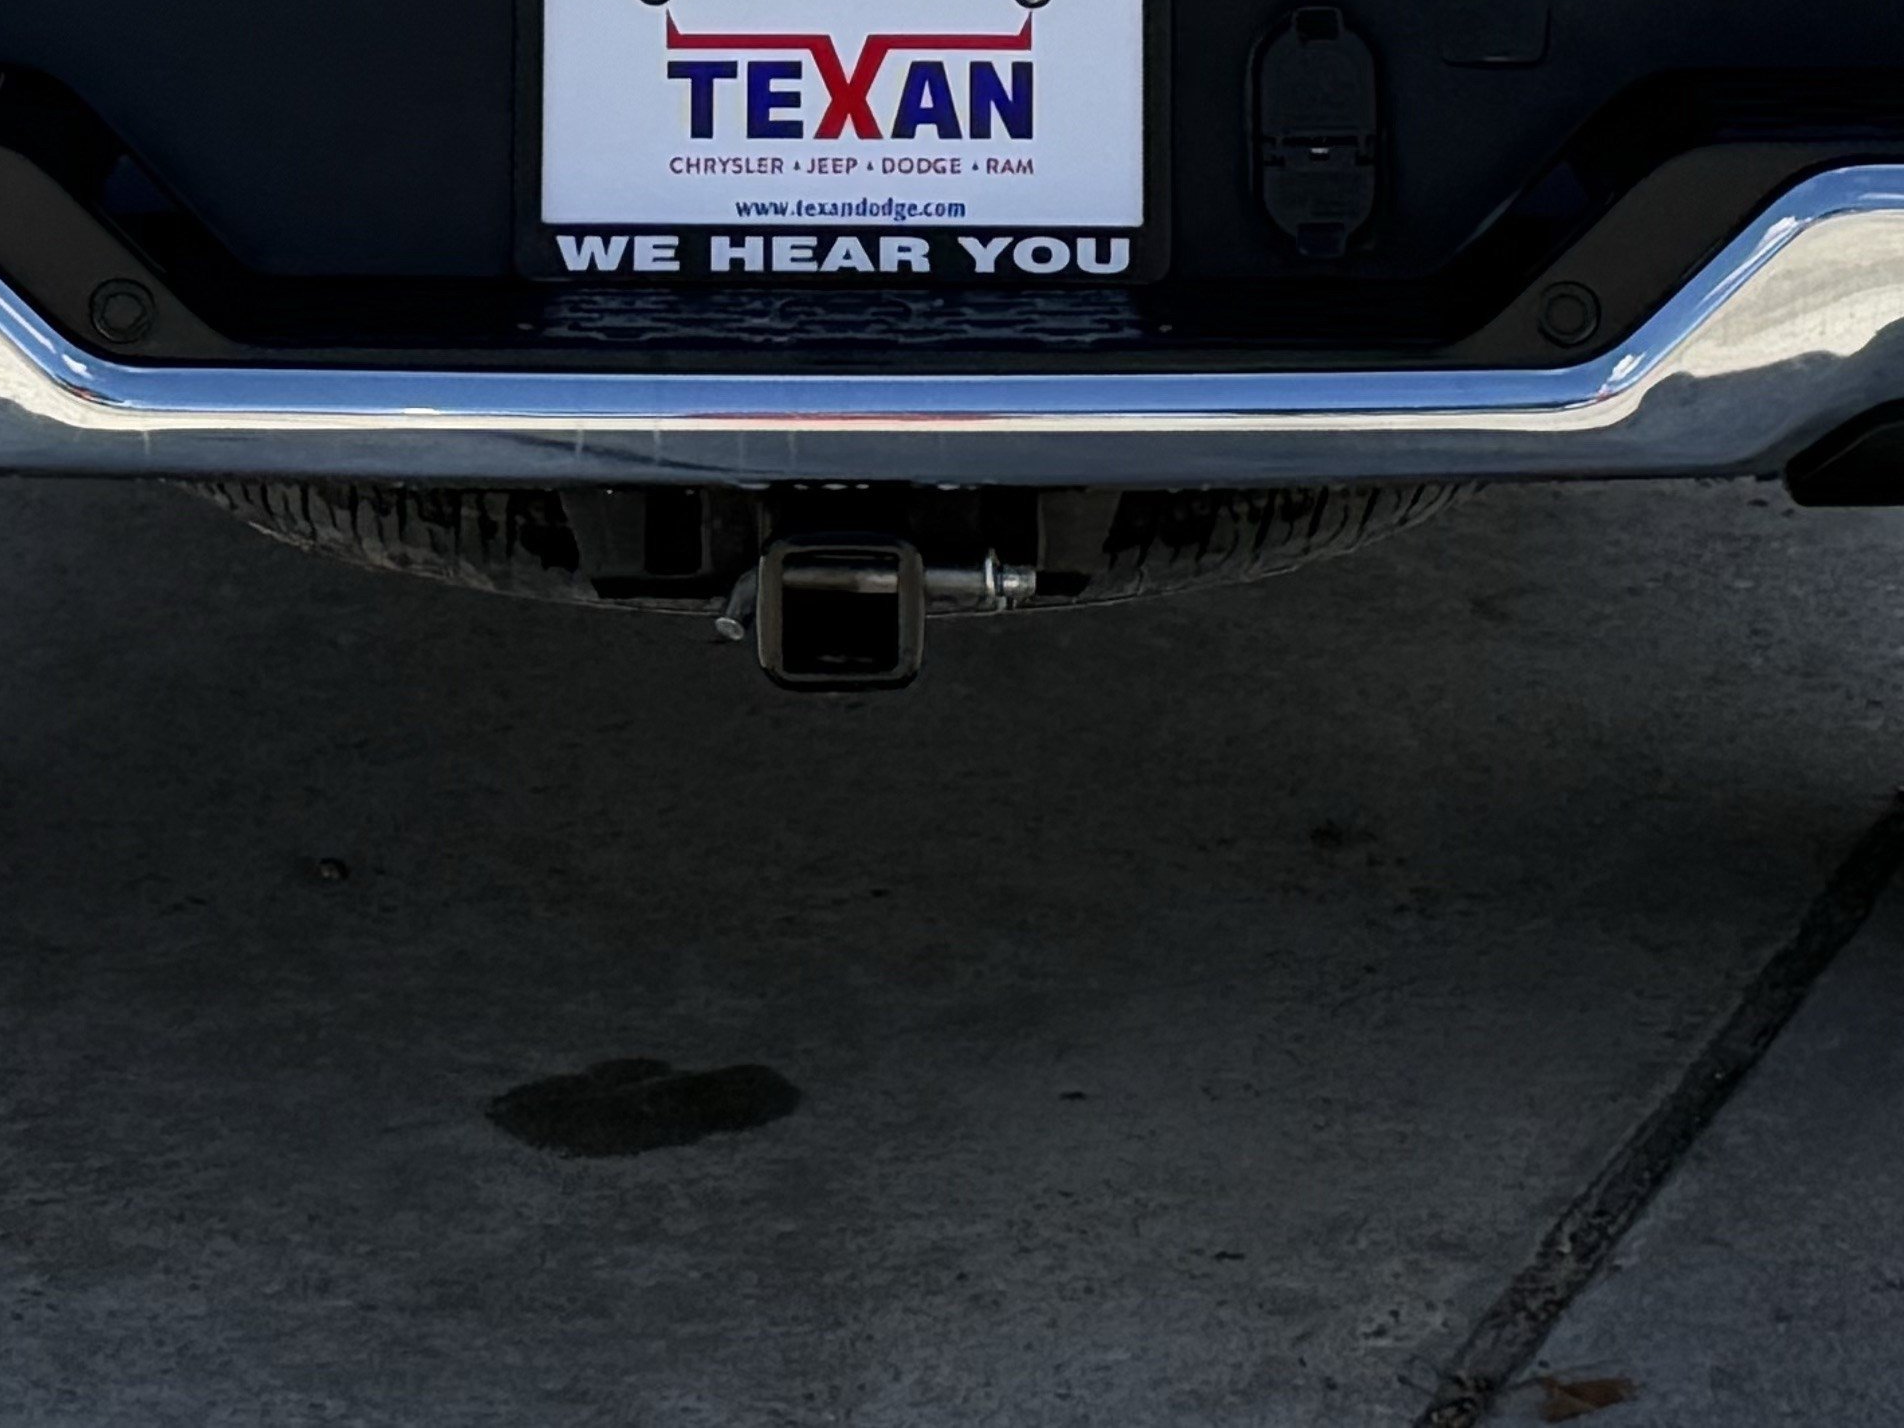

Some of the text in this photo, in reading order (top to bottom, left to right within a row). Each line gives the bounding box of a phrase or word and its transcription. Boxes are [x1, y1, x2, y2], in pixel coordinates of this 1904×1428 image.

[666, 33, 1034, 140] TEXAN
[669, 156, 1035, 175] CHRYSLER JEEP DODGE RAM
[735, 196, 966, 221] www.texandodge.com
[555, 235, 1131, 274] WE HEAR YOU
